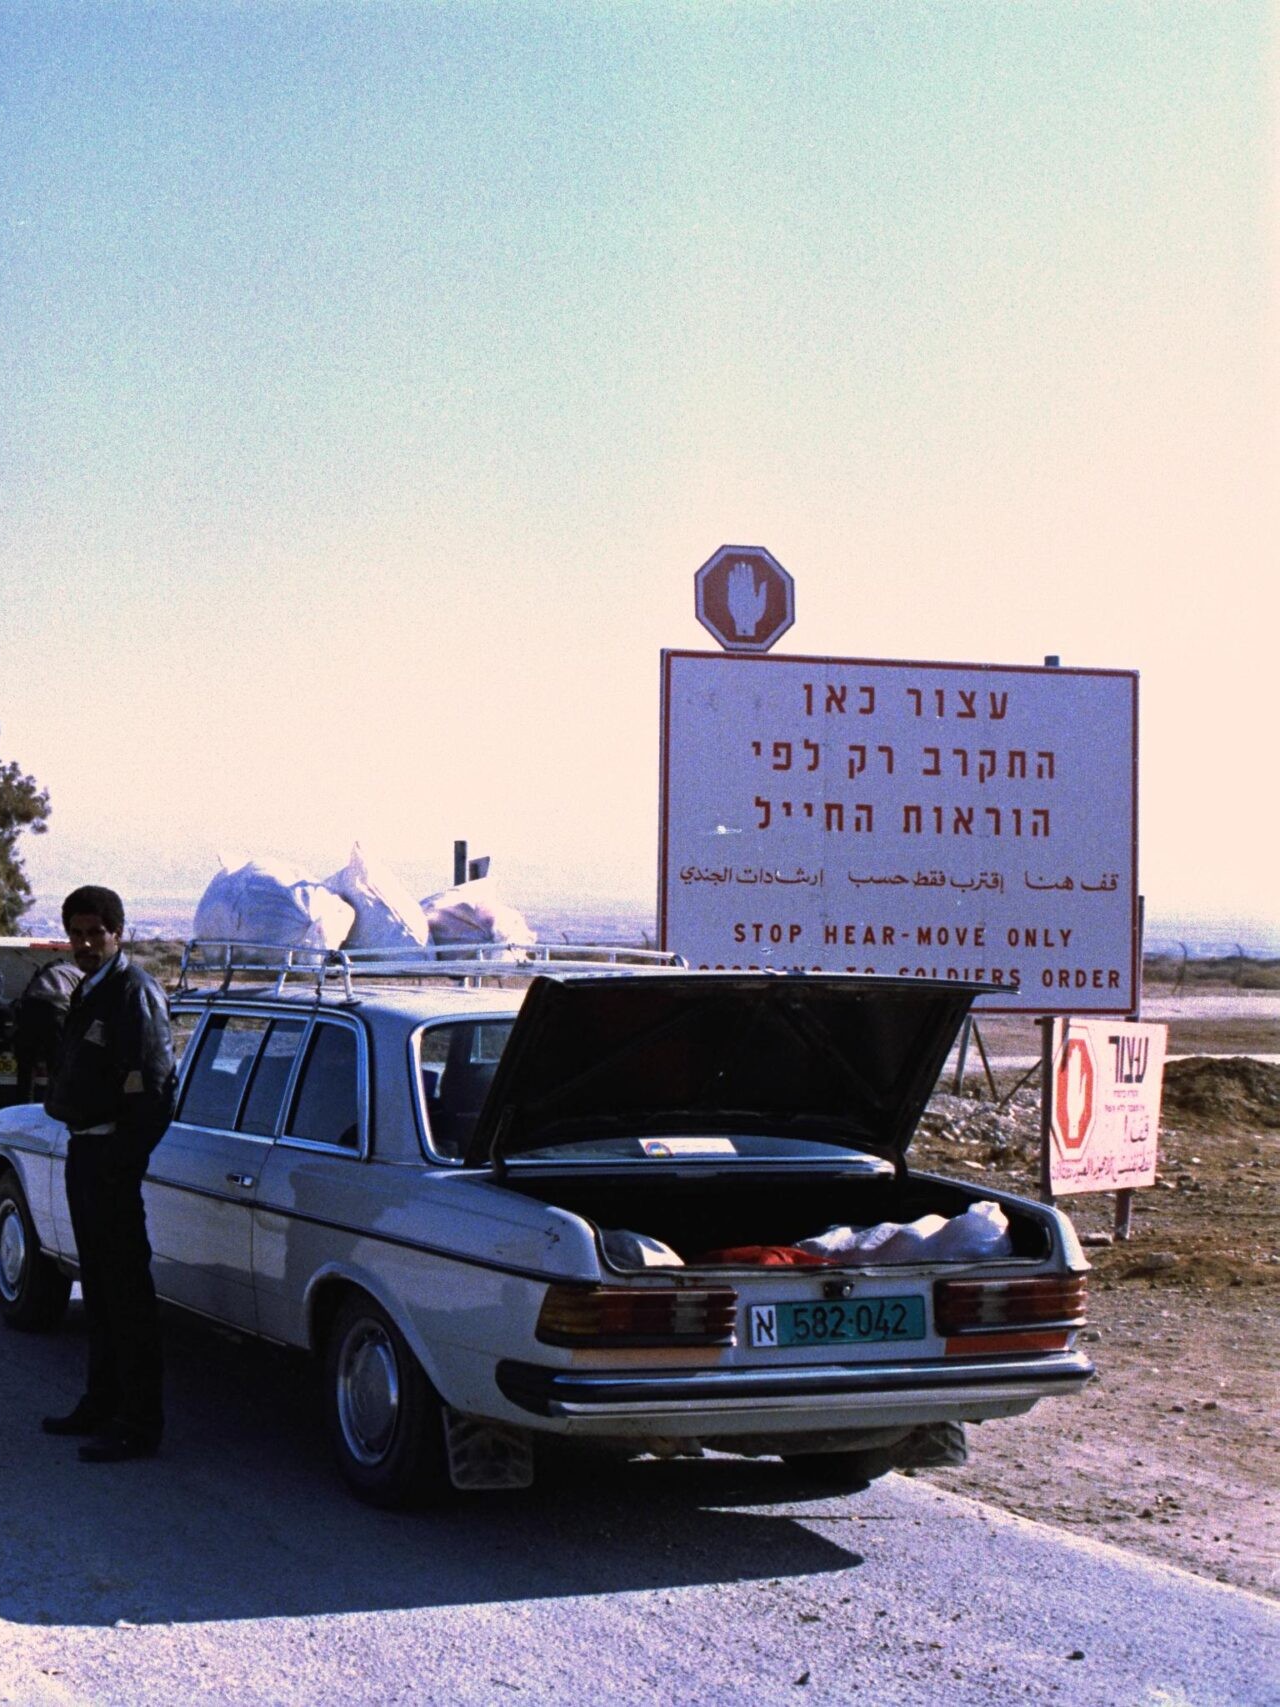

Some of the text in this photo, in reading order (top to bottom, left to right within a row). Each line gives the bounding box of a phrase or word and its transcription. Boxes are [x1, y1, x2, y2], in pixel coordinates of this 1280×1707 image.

[802, 683, 1008, 720] עצור כאן
[751, 738, 1055, 784] התקרב רק לפי
[754, 796, 1050, 837] הוראות החייל
[679, 865, 733, 886] الجندي
[848, 870, 909, 889] حسب
[912, 871, 946, 889] فقط
[1081, 872, 1119, 891] قف
[733, 923, 1073, 948] STOP HEAR-MOVE ONLY
[1041, 968, 1121, 989] ORDER
